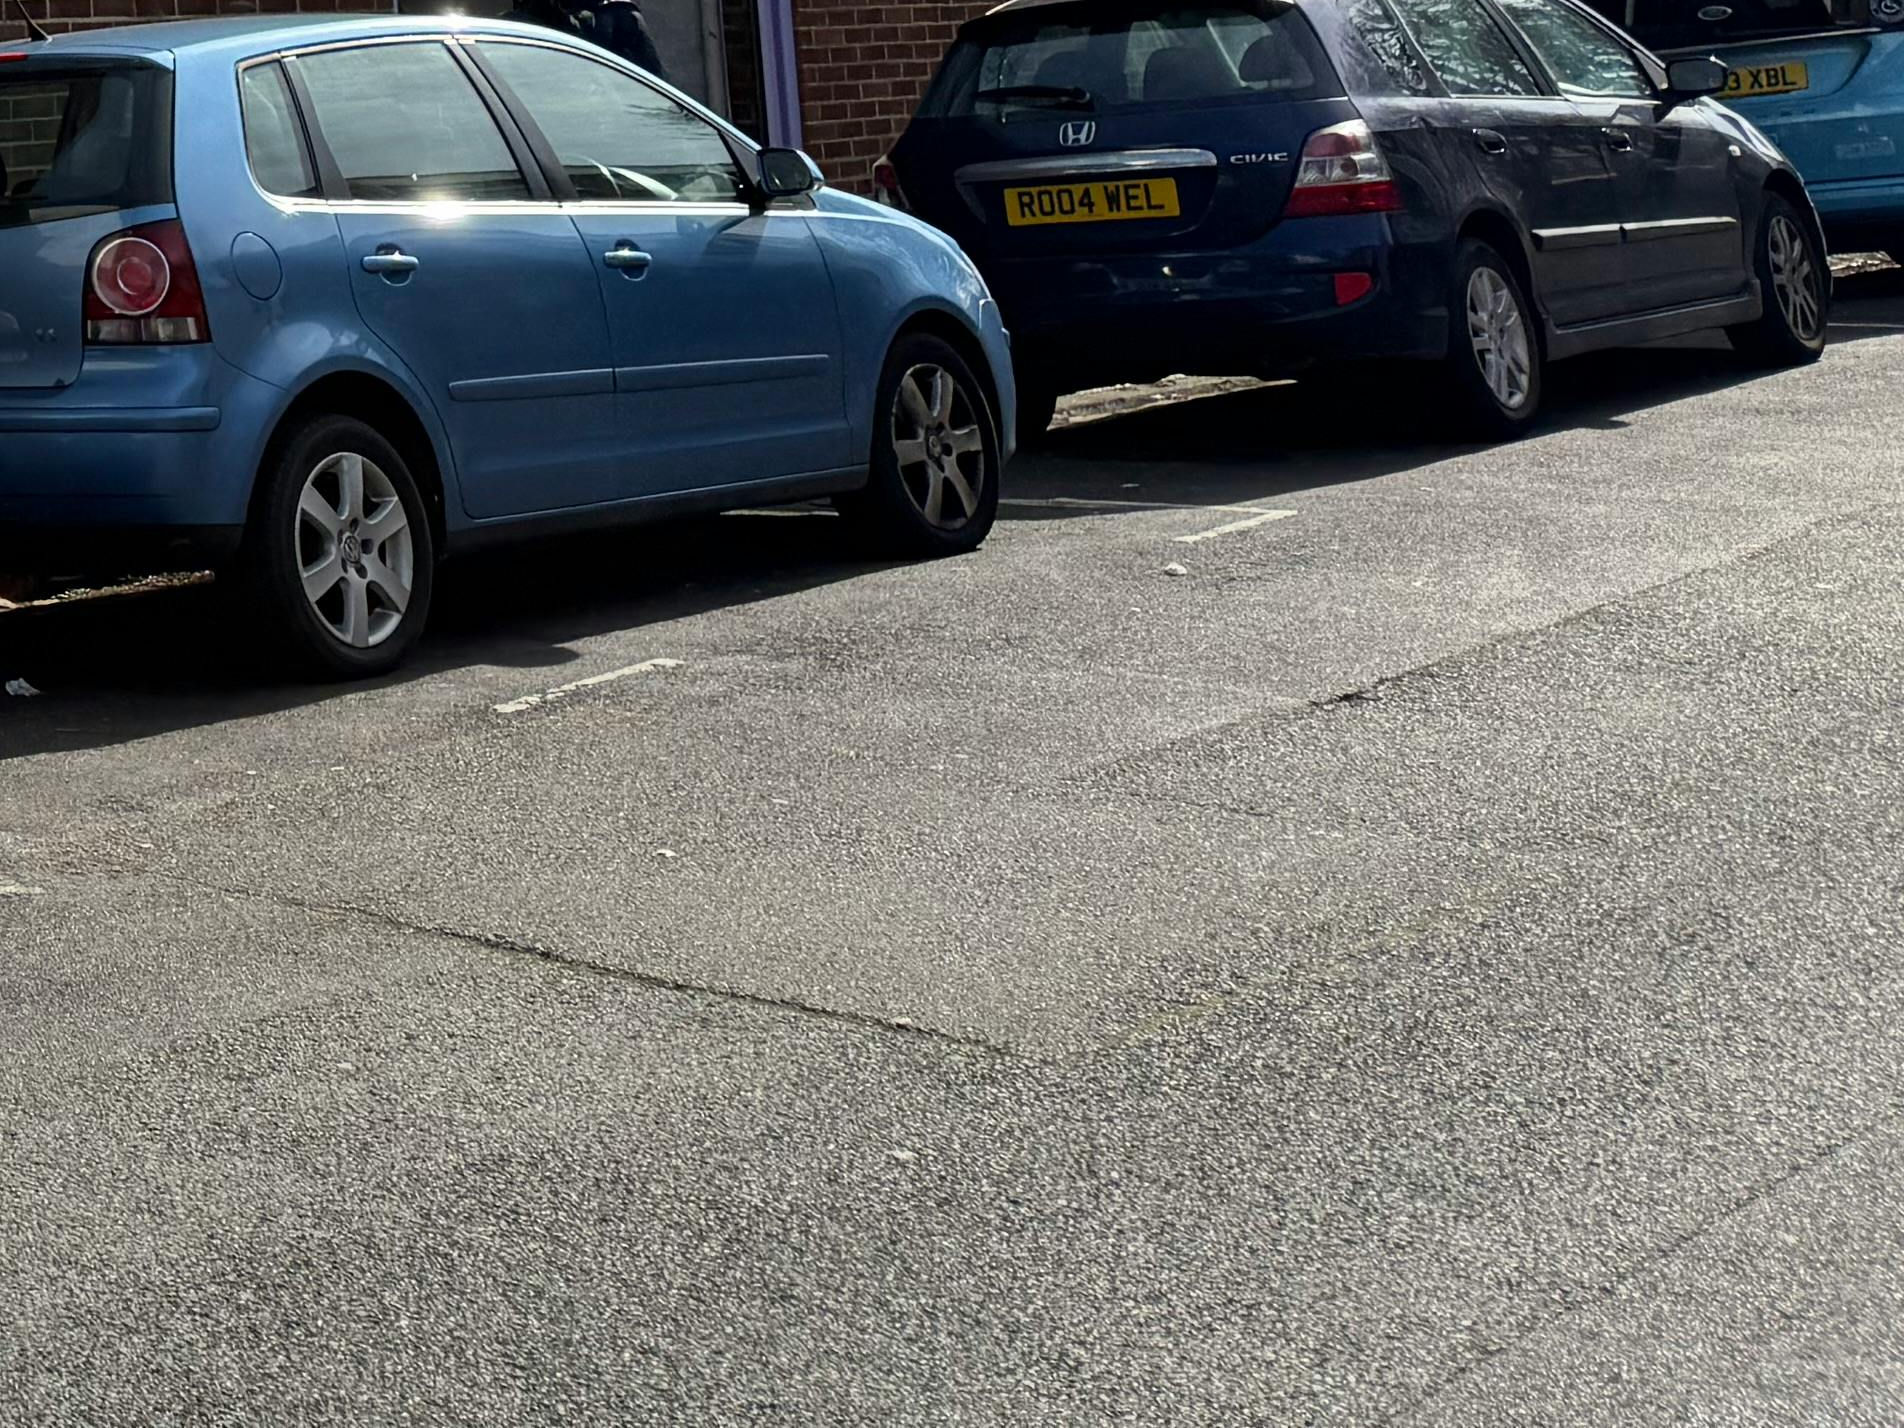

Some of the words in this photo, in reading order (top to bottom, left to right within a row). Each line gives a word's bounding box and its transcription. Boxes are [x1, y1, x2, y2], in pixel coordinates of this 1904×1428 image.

[1748, 65, 1797, 89] XBL
[1230, 152, 1289, 165] CIVIC
[1017, 187, 1095, 219] RO04
[1103, 183, 1165, 213] WEL
